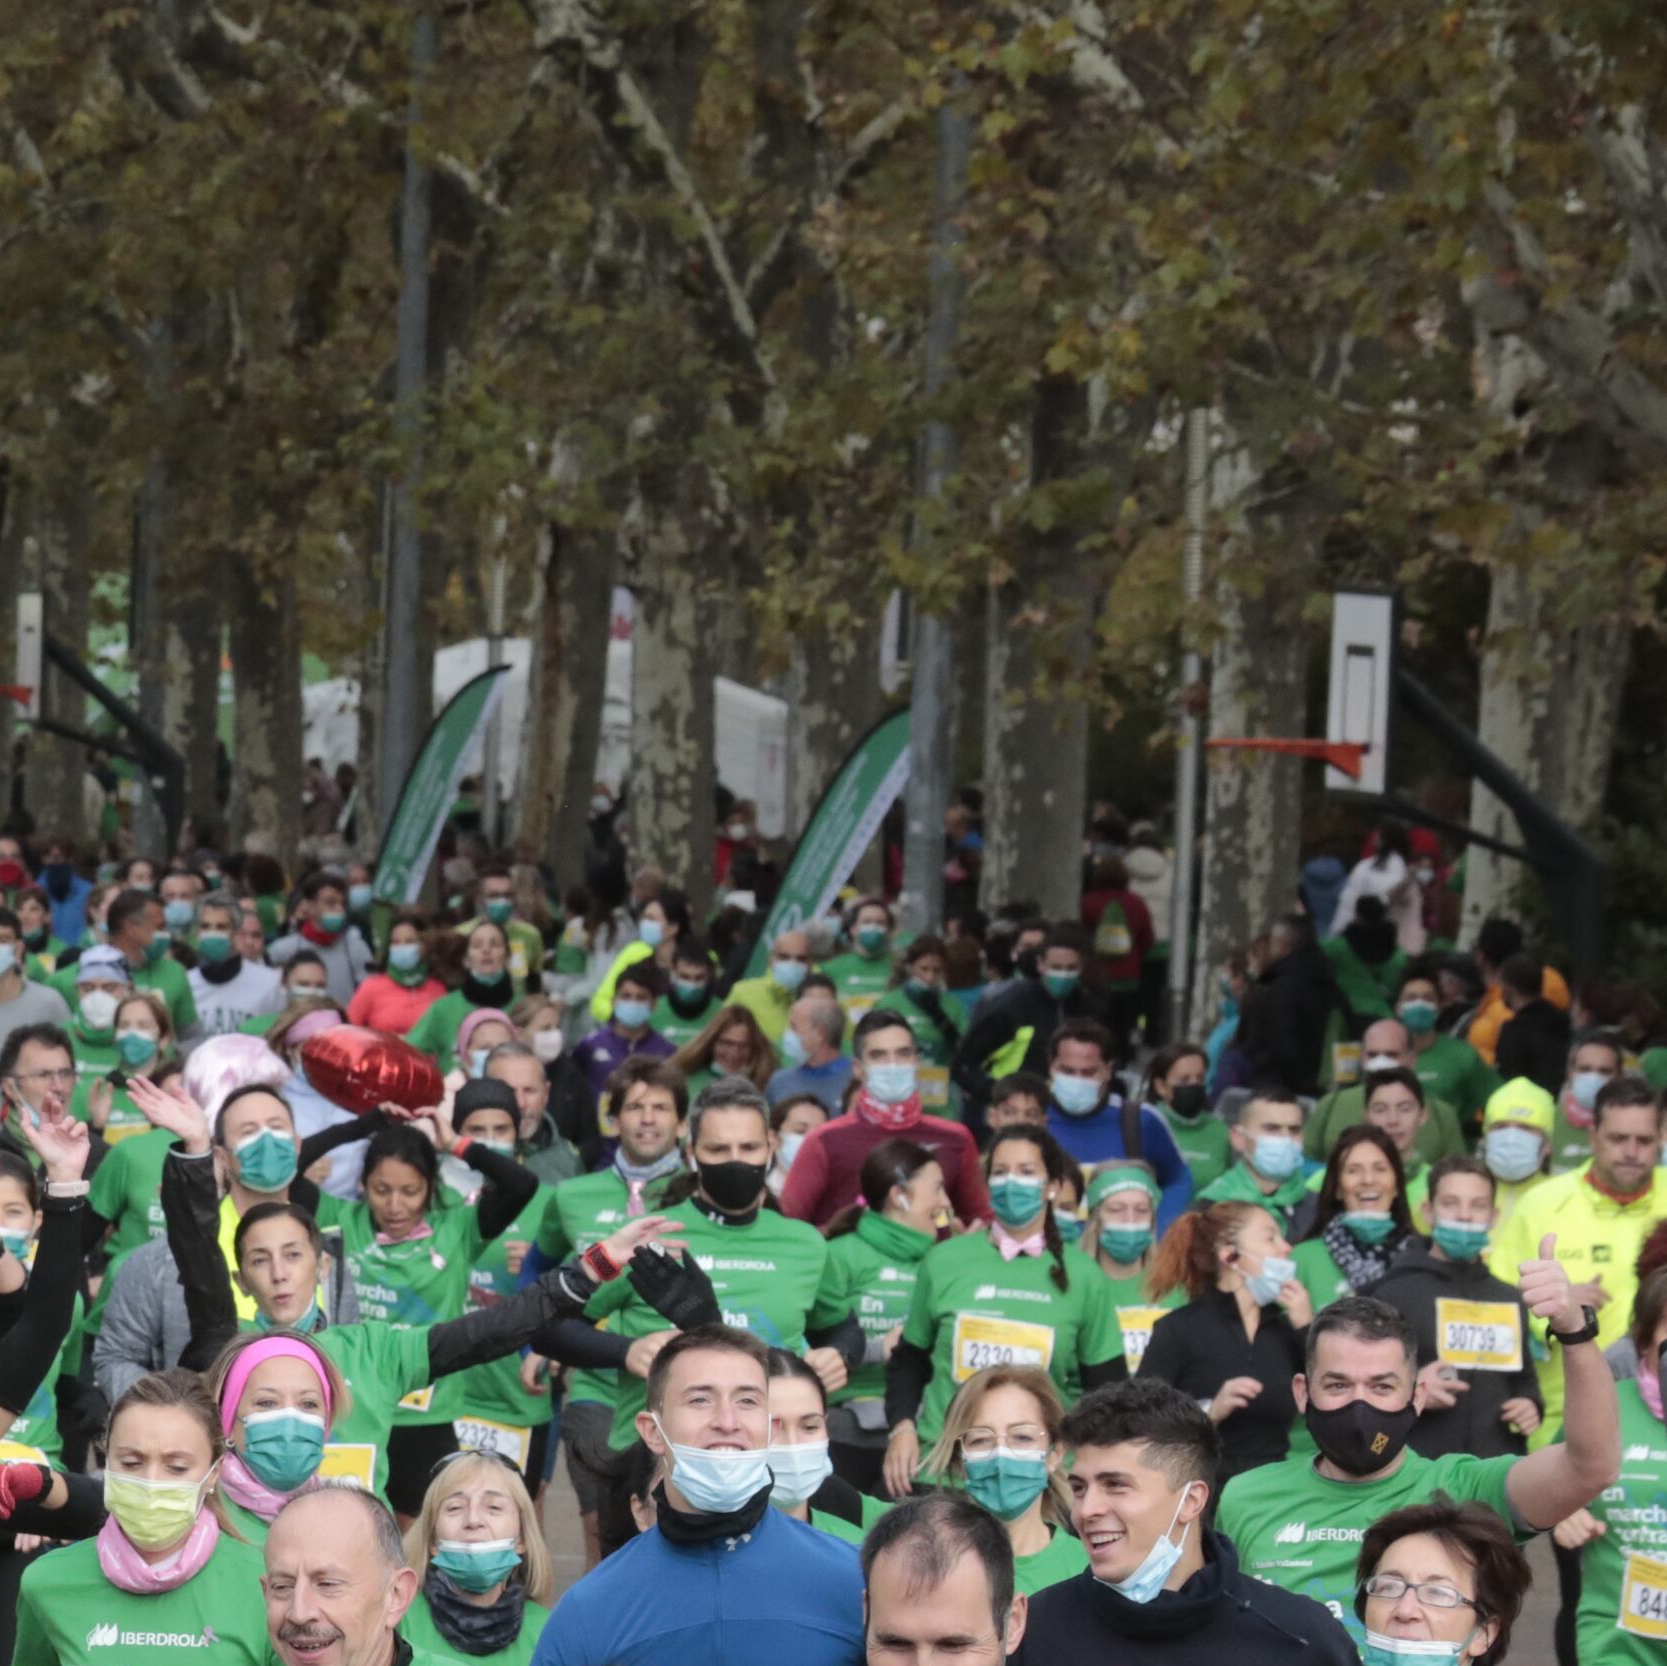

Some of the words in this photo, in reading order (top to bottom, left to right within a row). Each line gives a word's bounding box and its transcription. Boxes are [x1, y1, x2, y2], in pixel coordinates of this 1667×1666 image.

[715, 1260, 777, 1271] IBERDROLA
[1448, 1324, 1497, 1351] 30739
[458, 1422, 499, 1449] 2325
[120, 1630, 208, 1648] IBERDROLA
